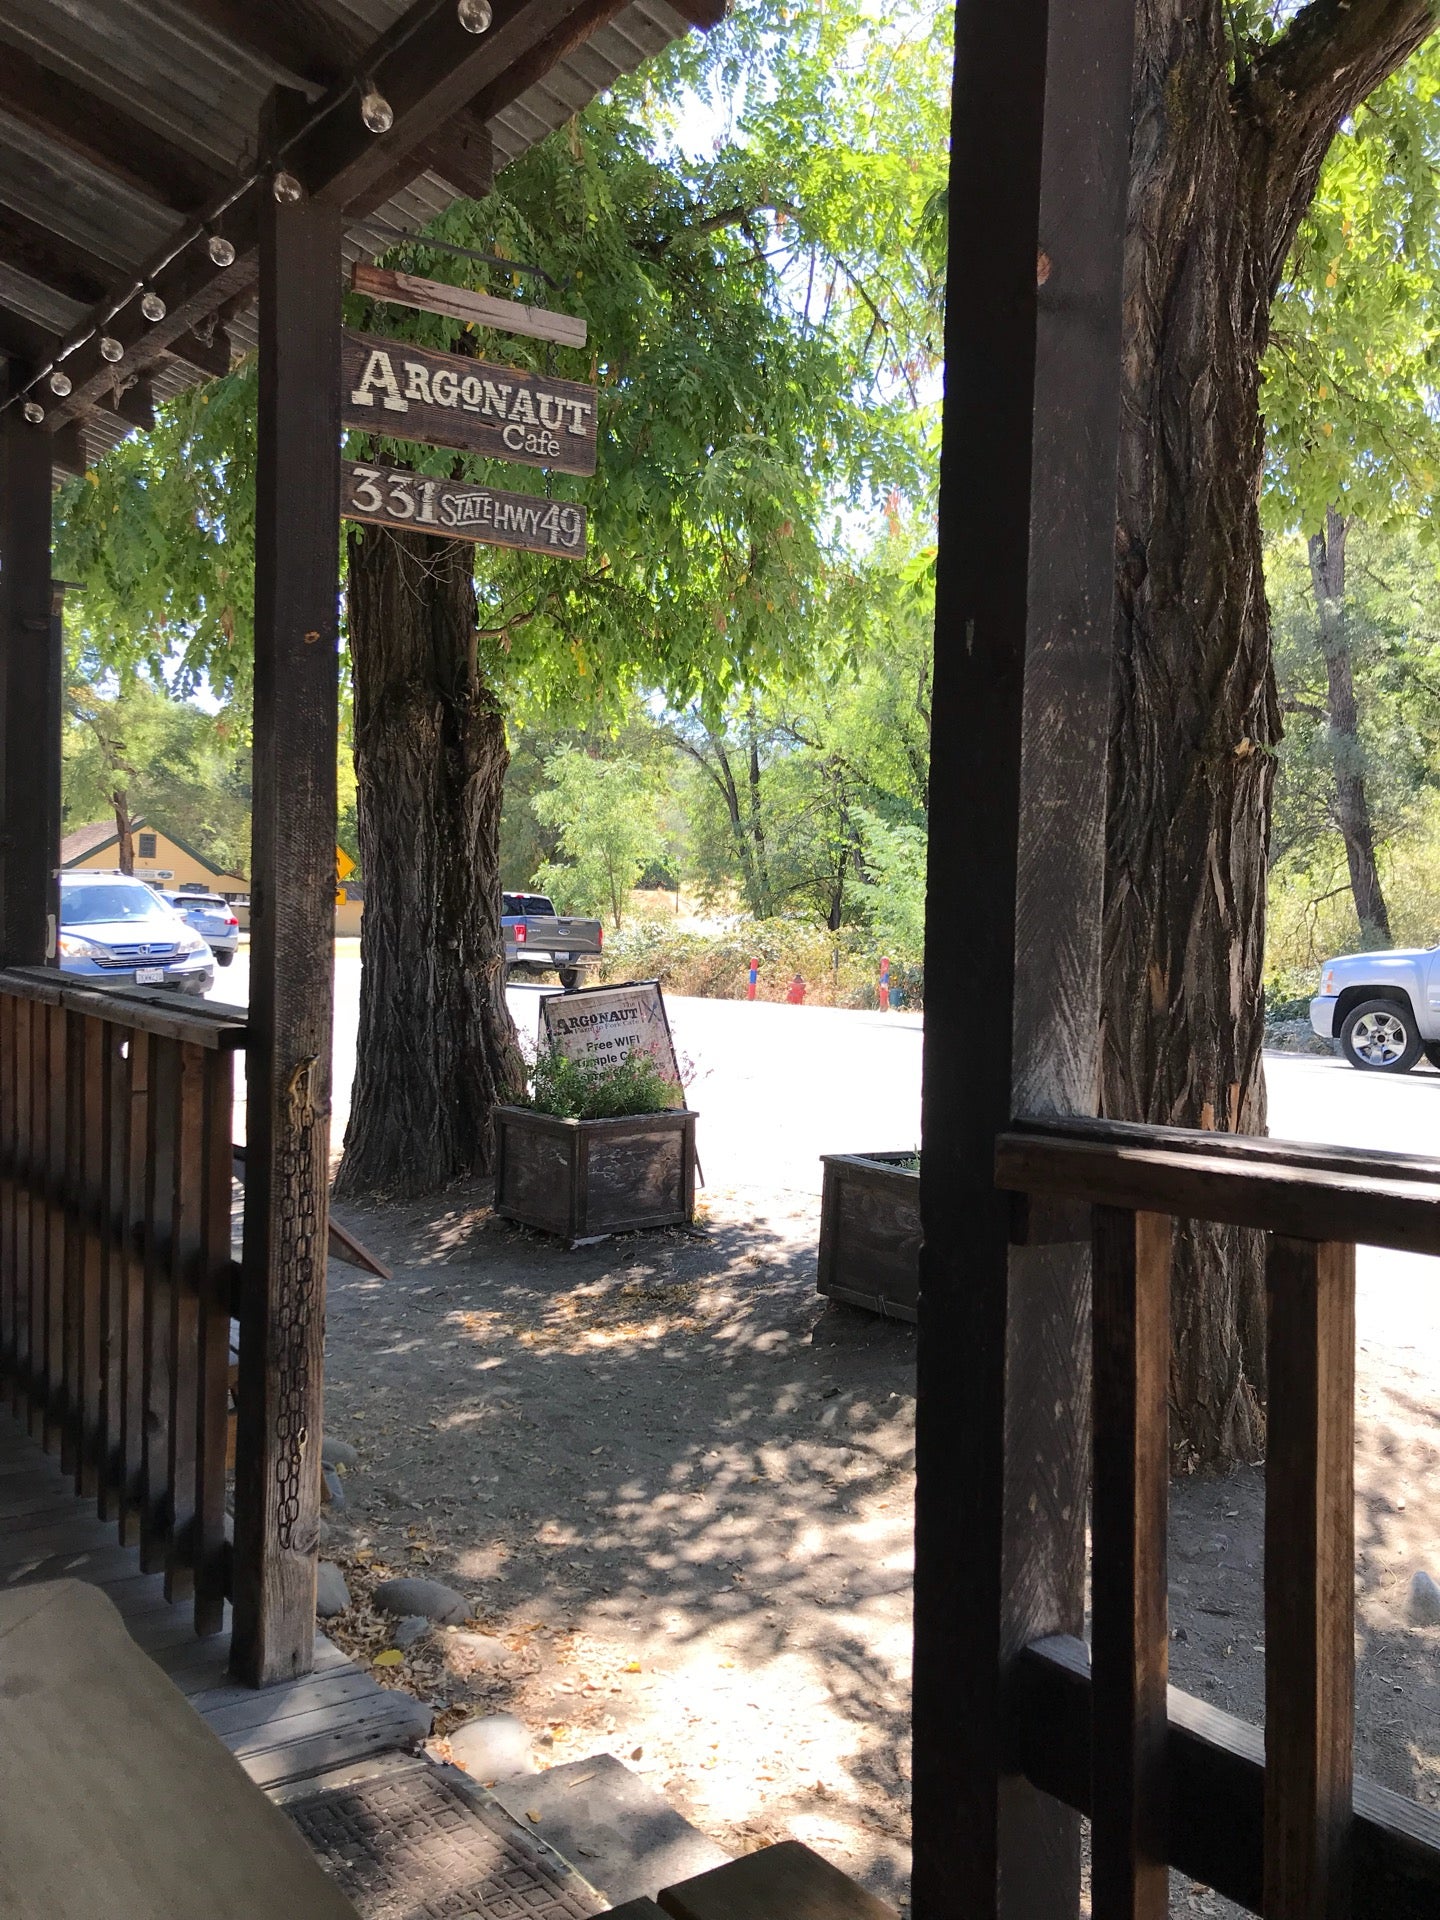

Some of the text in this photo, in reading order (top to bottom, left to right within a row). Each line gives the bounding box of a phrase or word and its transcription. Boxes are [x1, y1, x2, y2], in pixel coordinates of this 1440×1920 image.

[351, 350, 592, 436] ARGONAUT
[502, 424, 561, 458] Cafe
[351, 467, 582, 547] 331 STATE HWY 49
[553, 1008, 638, 1036] ARGONAUT
[574, 1026, 594, 1034] Farm
[605, 1021, 621, 1030] Fork
[586, 1035, 640, 1052] Free WIFI
